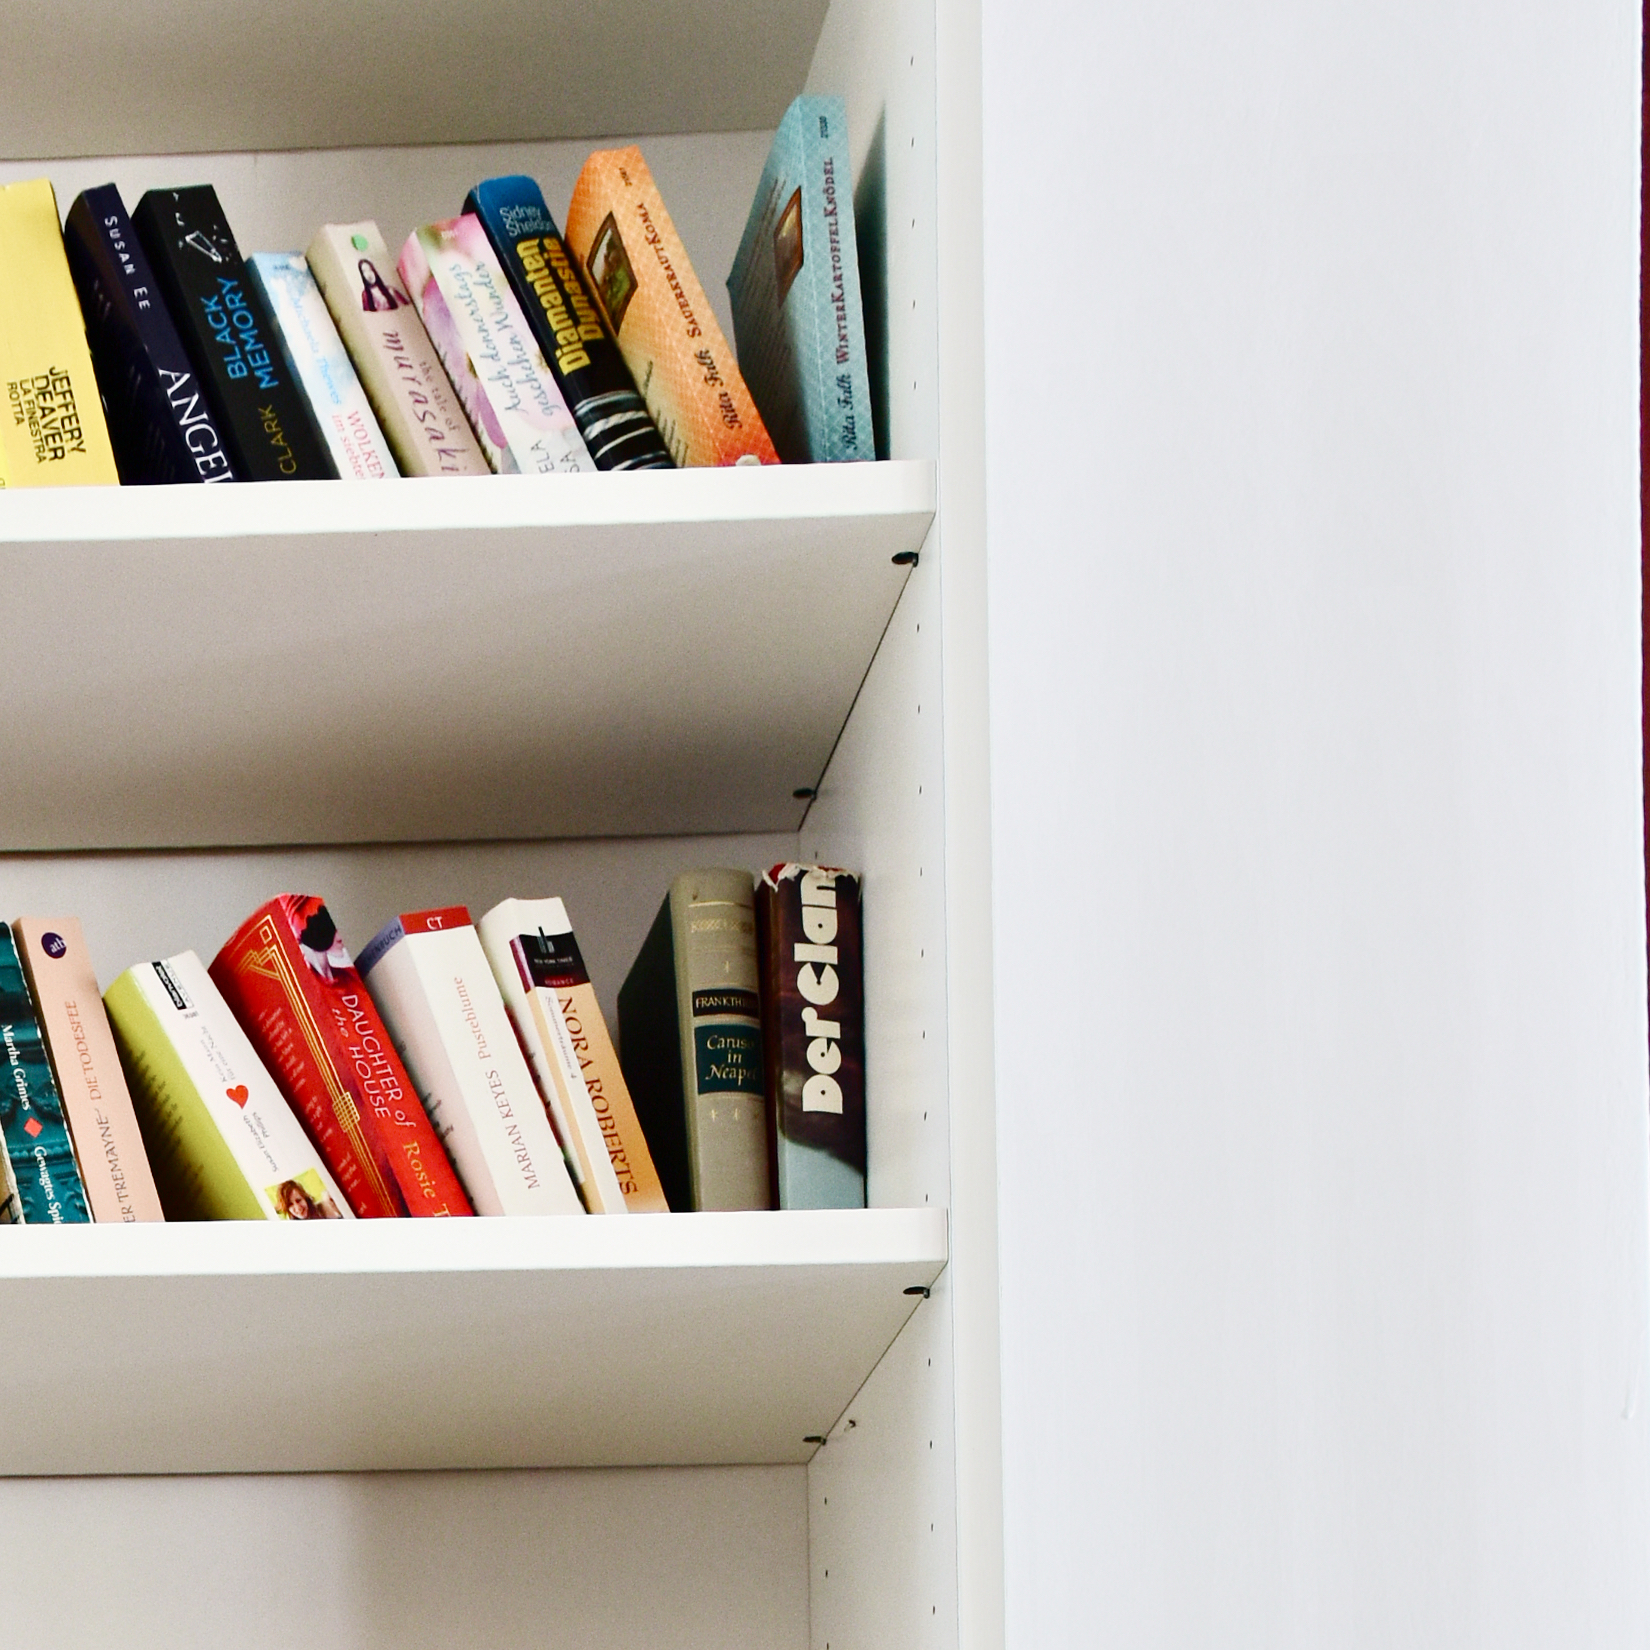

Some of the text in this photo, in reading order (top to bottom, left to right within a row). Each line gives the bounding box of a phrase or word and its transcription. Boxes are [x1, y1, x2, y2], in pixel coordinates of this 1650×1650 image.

[105, 215, 151, 311] SUSAN EE
[201, 296, 249, 379] BLACK
[217, 276, 280, 389] MEMORY
[7, 382, 25, 426] ROTTA
[20, 379, 47, 464] LA FINESTRA
[34, 375, 65, 461] DEAVER
[49, 366, 87, 454] JEFFERY
[258, 404, 297, 475] CLARK
[794, 872, 844, 1115] Der Clan
[1, 1024, 31, 1111] Martha Grimes
[342, 994, 416, 1128] DAUGHTER of
[349, 1045, 391, 1120] HOUSE
[454, 976, 540, 1190] MARIAN KEYES Pusteblume
[558, 997, 639, 1195] NORA ROBERTS
[403, 1140, 436, 1201] Rosie
